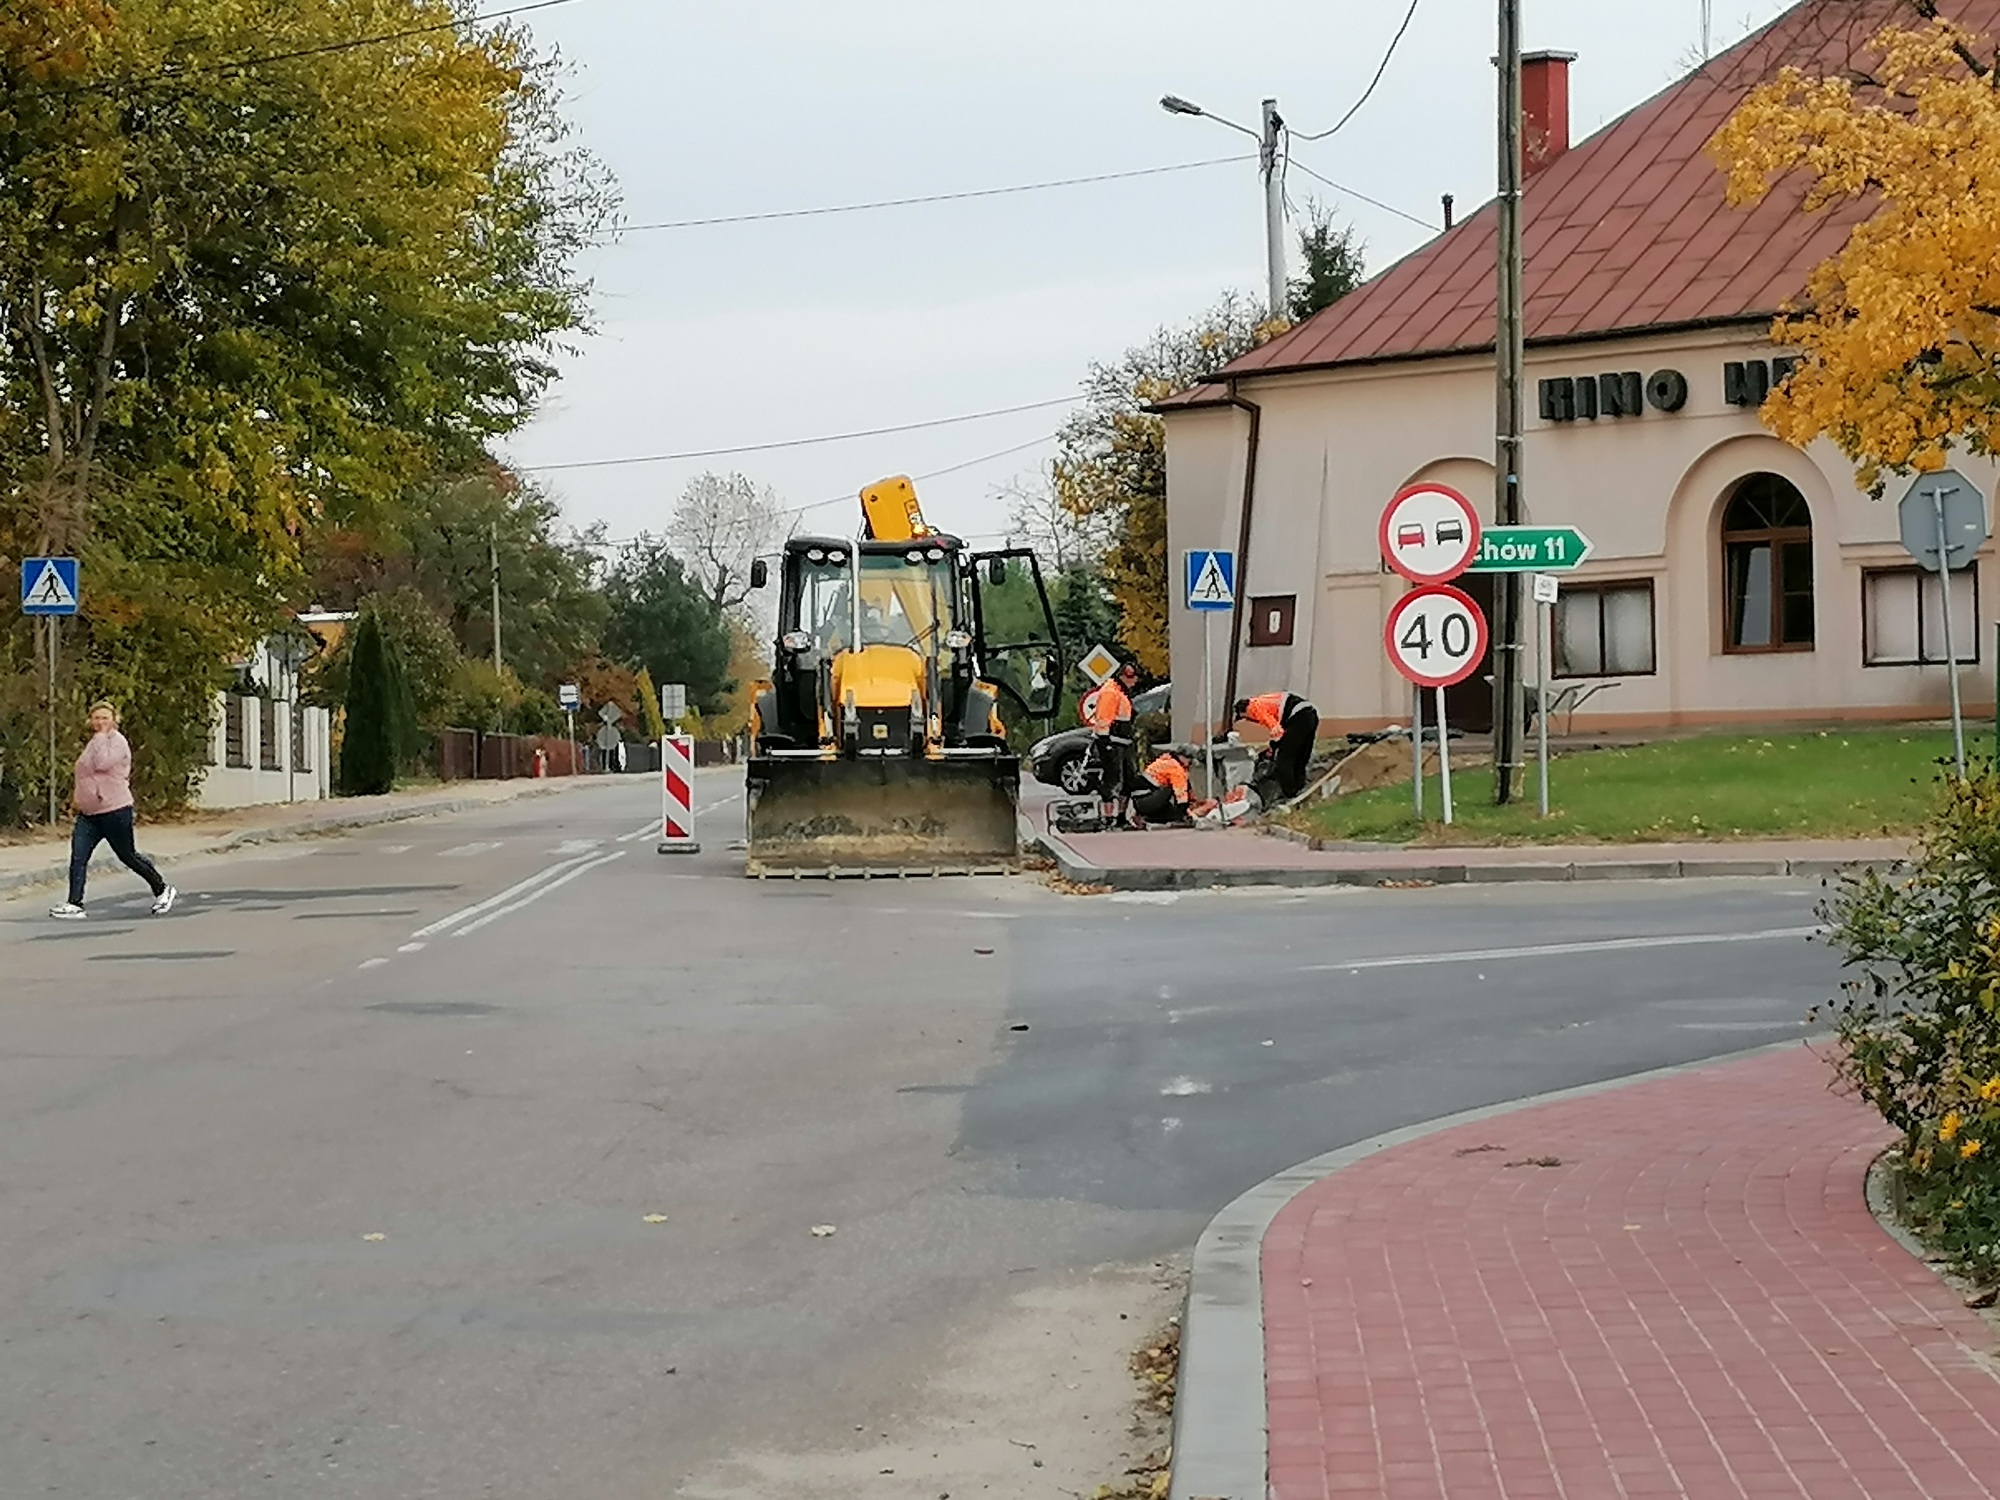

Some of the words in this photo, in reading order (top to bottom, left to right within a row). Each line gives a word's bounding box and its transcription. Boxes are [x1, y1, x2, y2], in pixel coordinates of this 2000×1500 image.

[1538, 369, 1687, 422] KINO
[1544, 536, 1565, 560] 11
[1400, 613, 1470, 659] 40
